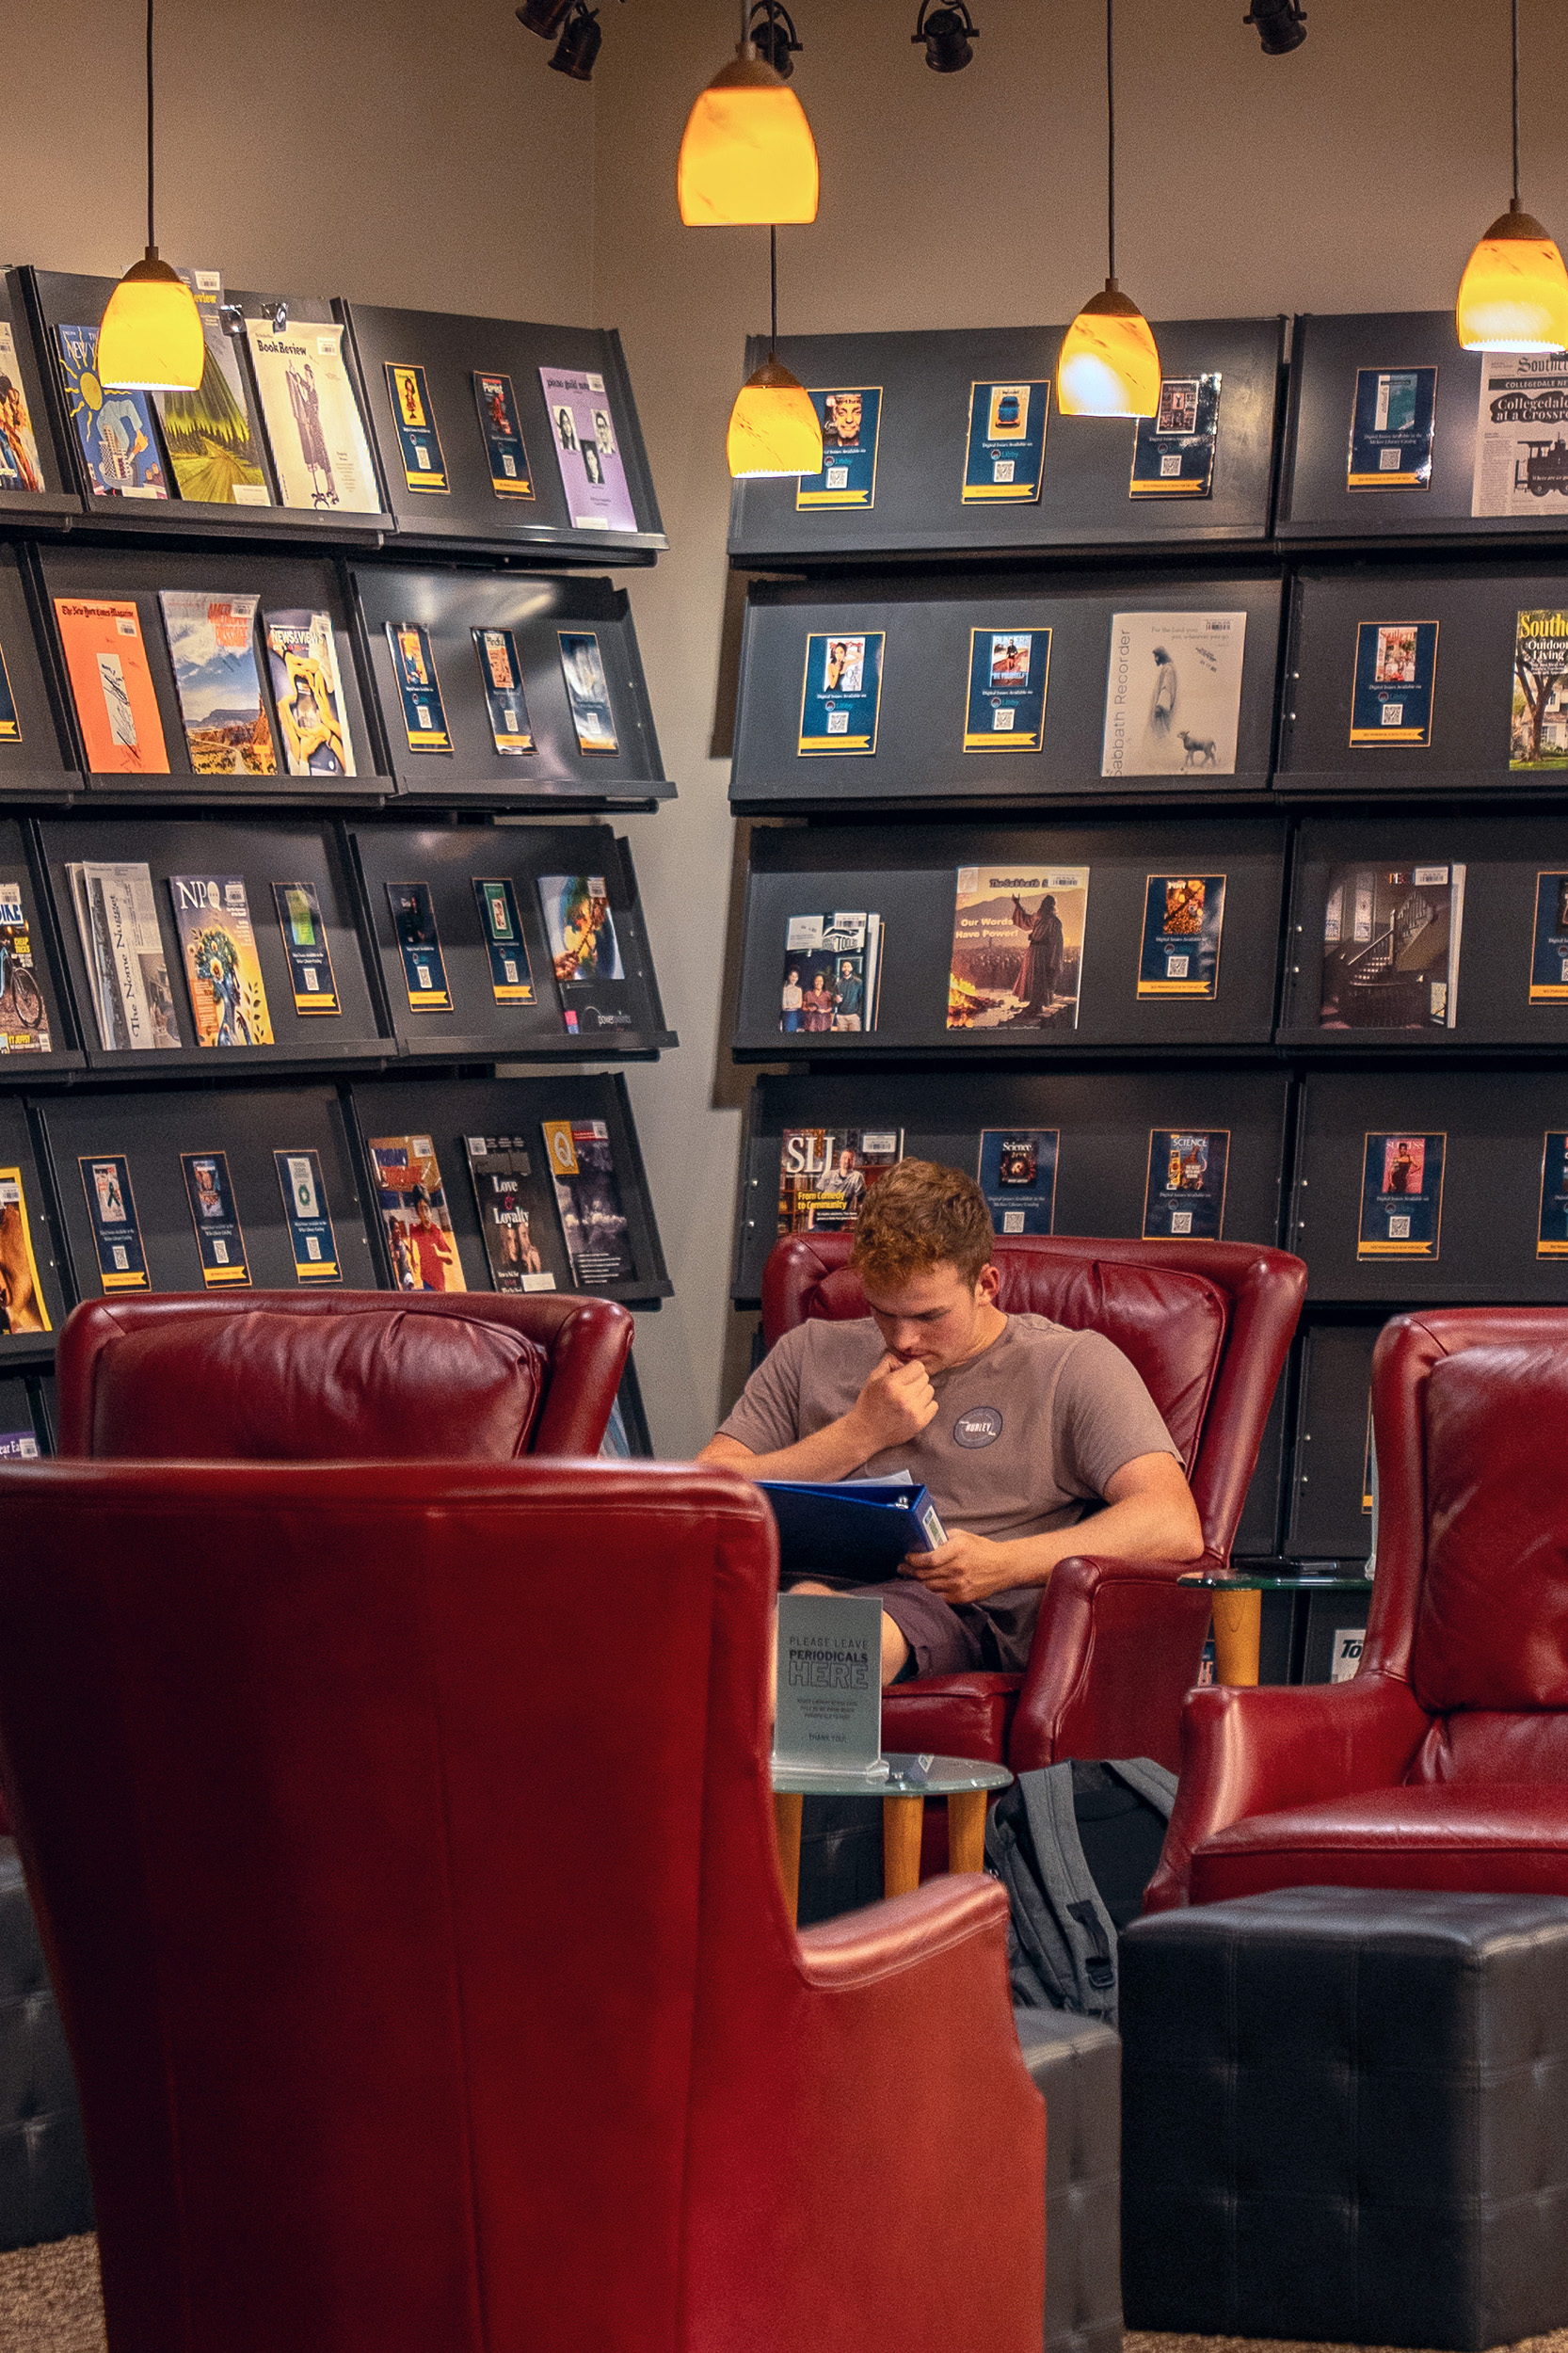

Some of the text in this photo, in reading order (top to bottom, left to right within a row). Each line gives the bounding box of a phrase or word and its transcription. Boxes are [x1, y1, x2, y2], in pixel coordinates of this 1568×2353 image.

[193, 293, 217, 304] eview
[257, 340, 307, 356] Book Review
[1505, 380, 1556, 389] COLLEGEDALE
[1496, 411, 1508, 422] at
[1512, 411, 1519, 421] a
[61, 605, 72, 616] The
[72, 605, 84, 616] New
[111, 607, 134, 618] Magazine
[1520, 613, 1568, 639] South
[1534, 649, 1565, 662] Living
[1113, 629, 1132, 705] Recorder
[989, 878, 1004, 888] The
[1004, 878, 1040, 888] Sabbath
[176, 880, 223, 912] NPQ
[960, 917, 1015, 927] Our Words
[955, 930, 981, 939] Have
[109, 895, 140, 1037] The Nome Nugget
[1173, 1138, 1207, 1147] SCIENCE
[786, 1136, 836, 1175] SLJ
[492, 1176, 519, 1193] Love
[797, 1190, 845, 1202] From Comedy
[797, 1200, 847, 1210] to Community
[492, 1206, 530, 1228] Loyalty
[965, 1421, 992, 1433] HURLEY
[790, 1637, 868, 1649] PLEASE LEAVE
[1340, 1639, 1364, 1659] To
[789, 1649, 869, 1664] PERIODICALS
[789, 1660, 869, 1690] HERE
